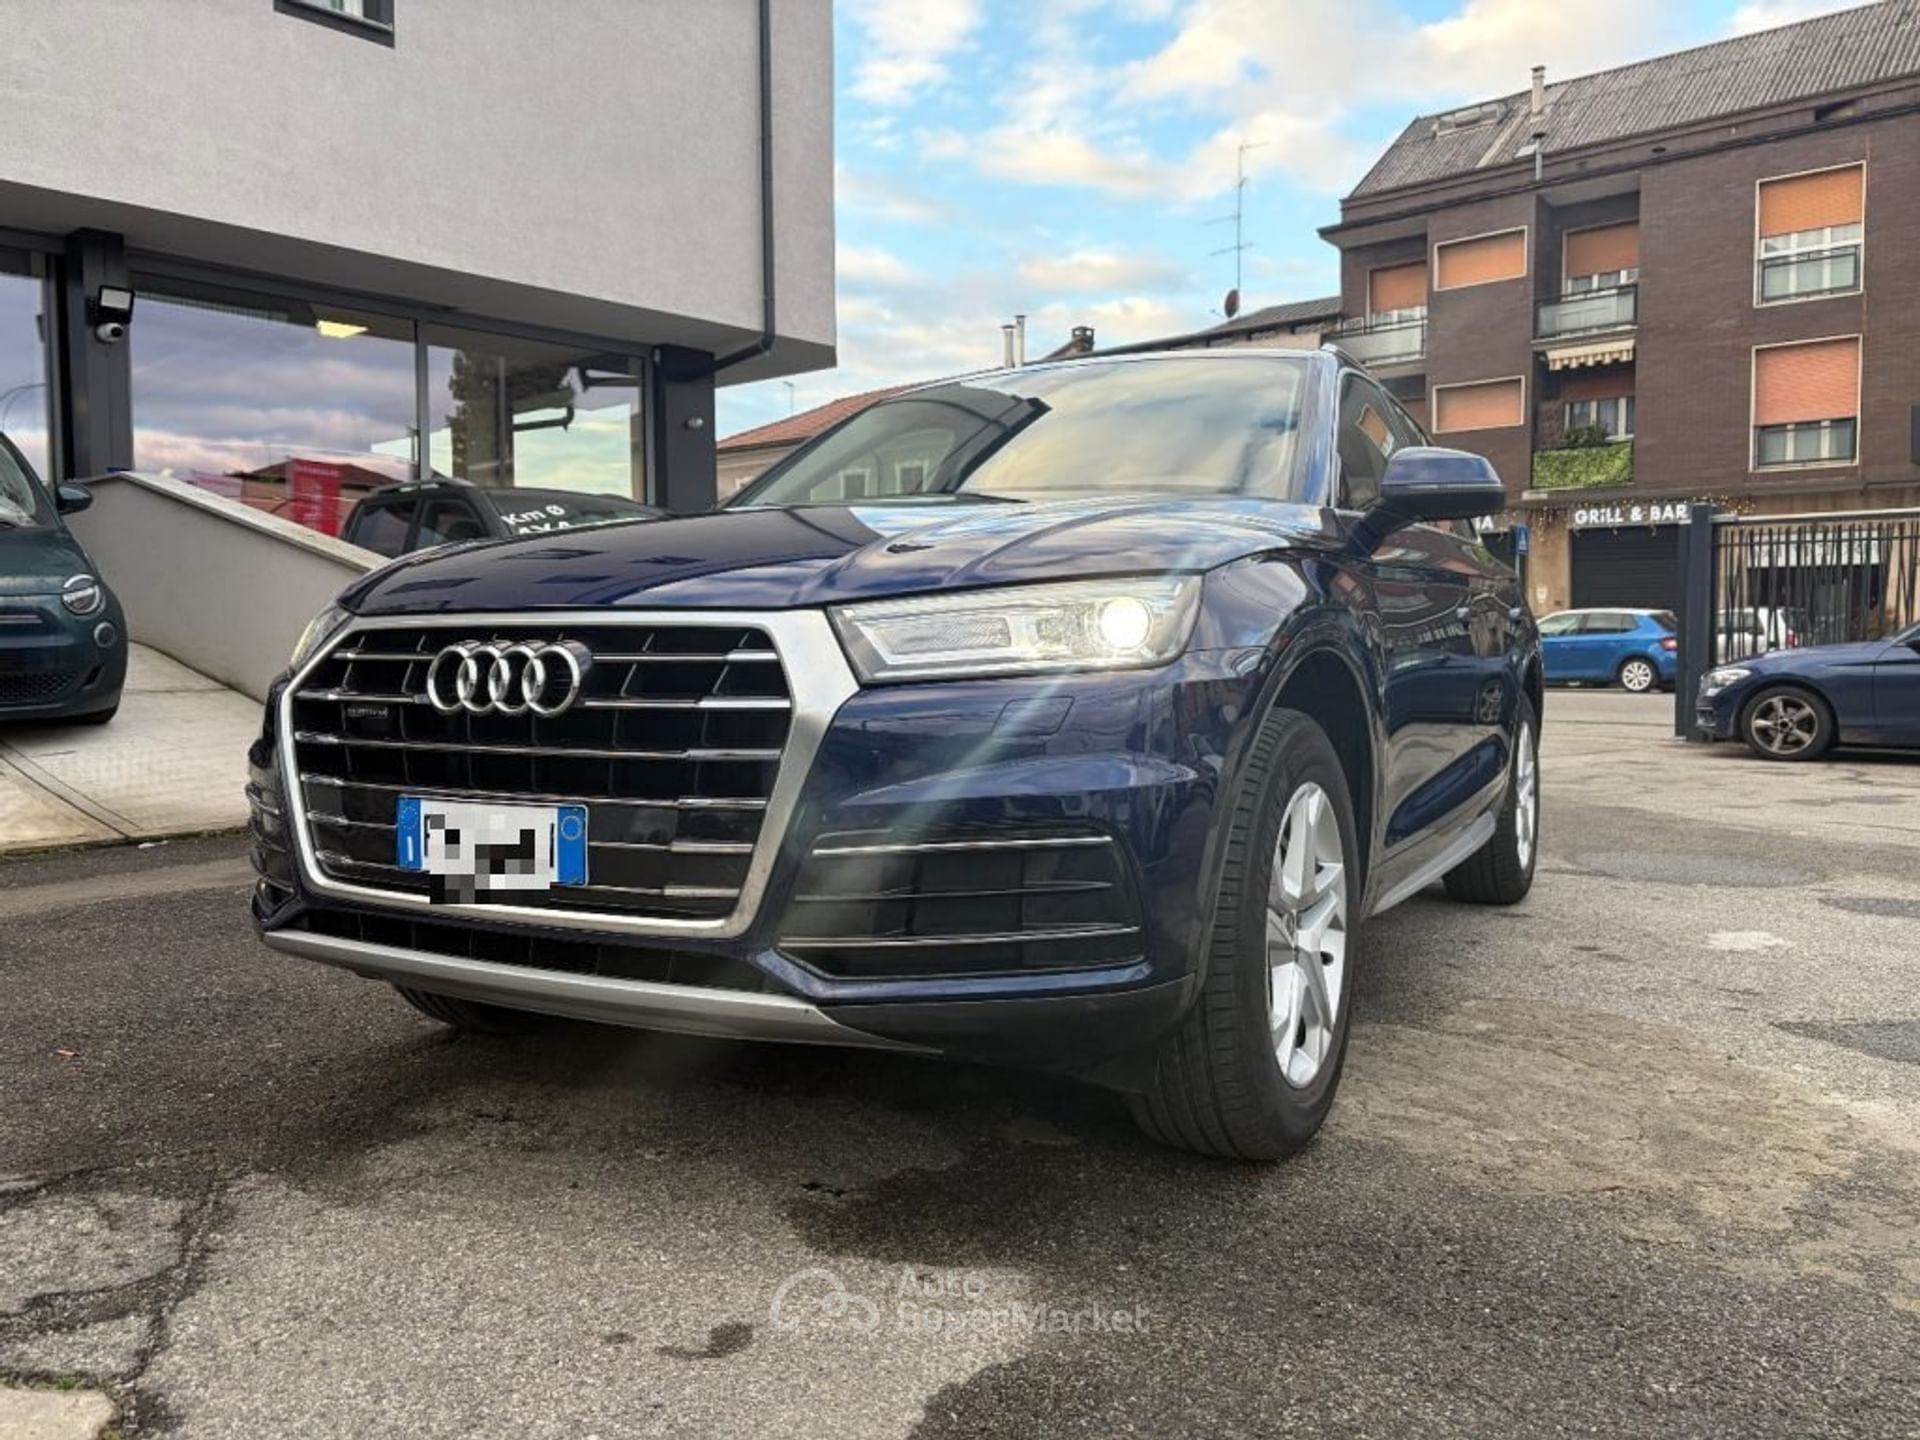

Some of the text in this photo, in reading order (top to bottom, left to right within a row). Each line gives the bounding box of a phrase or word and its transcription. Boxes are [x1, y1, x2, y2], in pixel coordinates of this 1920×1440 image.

[501, 509, 547, 526] Km
[1630, 505, 1647, 521] &
[1650, 503, 1689, 521] BAR
